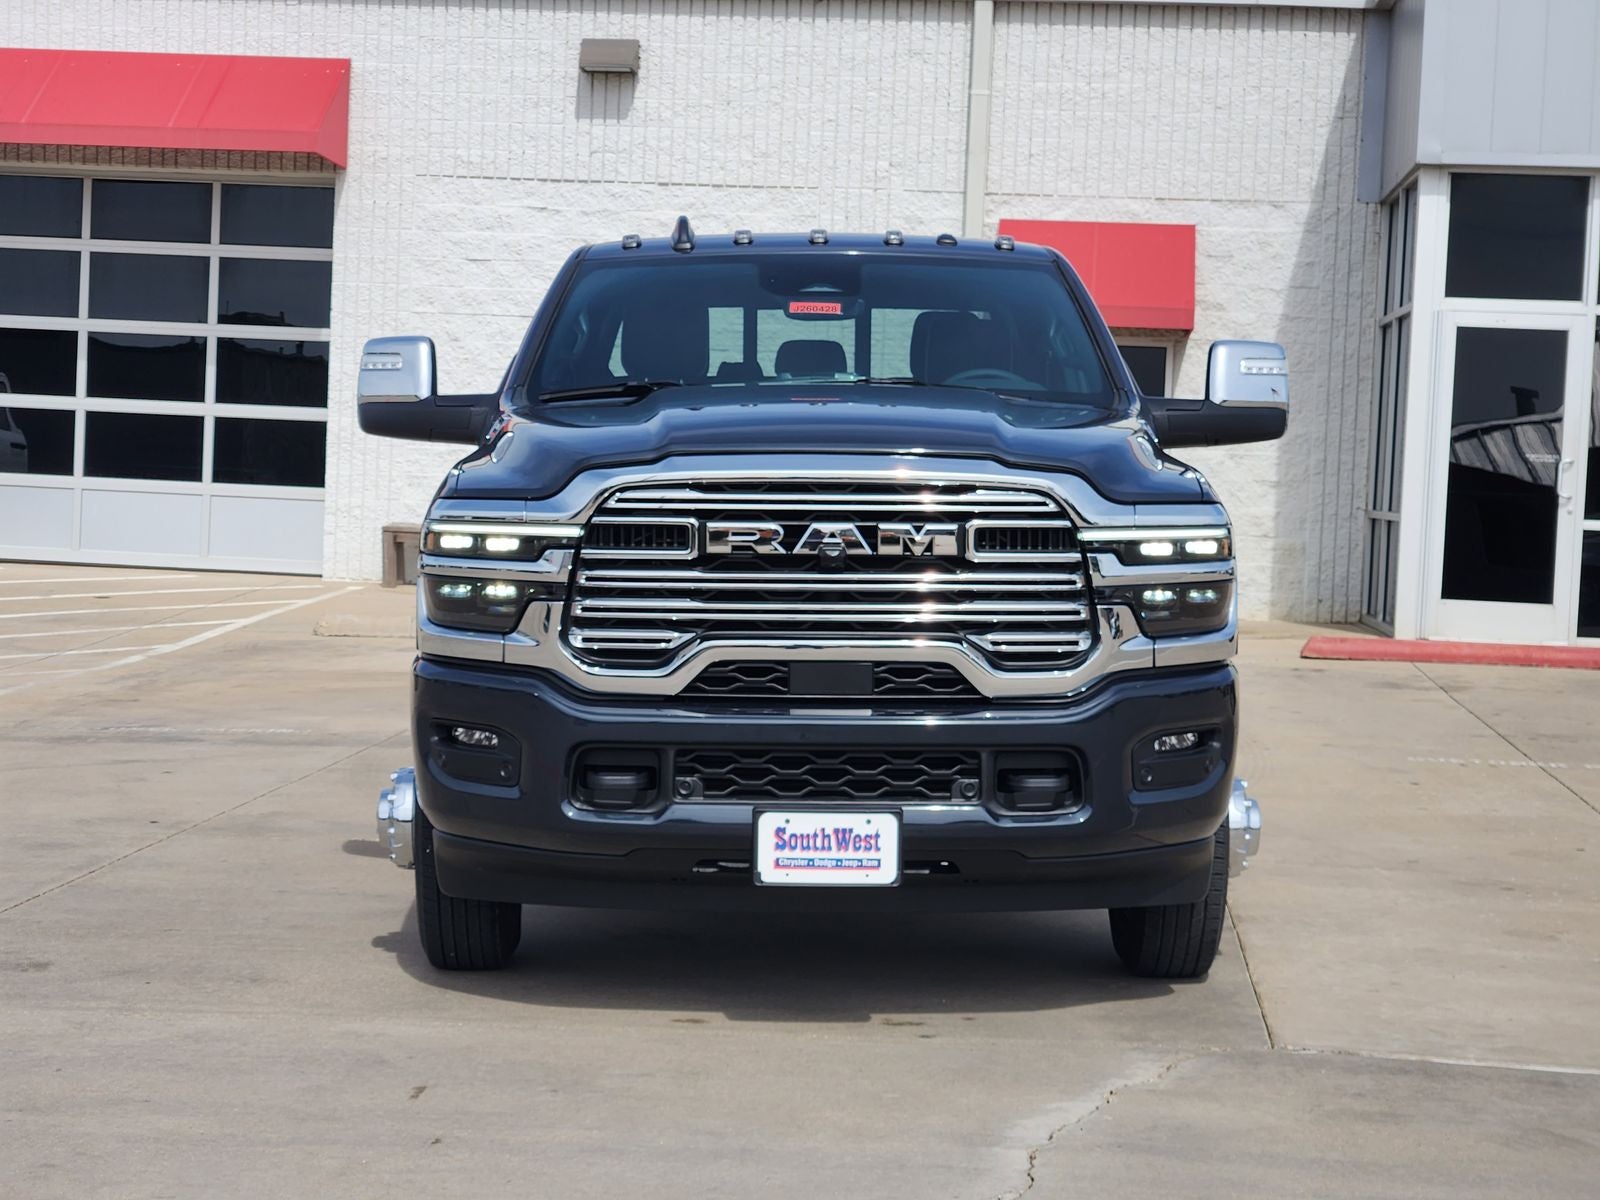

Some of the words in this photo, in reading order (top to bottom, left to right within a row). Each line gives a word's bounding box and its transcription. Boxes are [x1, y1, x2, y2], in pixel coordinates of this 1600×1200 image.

[793, 305, 837, 313] J260428
[706, 522, 958, 556] RAM
[774, 826, 880, 851] SouthWest
[778, 859, 809, 868] Chrysler
[813, 859, 837, 868] Dodge
[842, 859, 858, 868] Jeep
[861, 860, 879, 868] Ram
